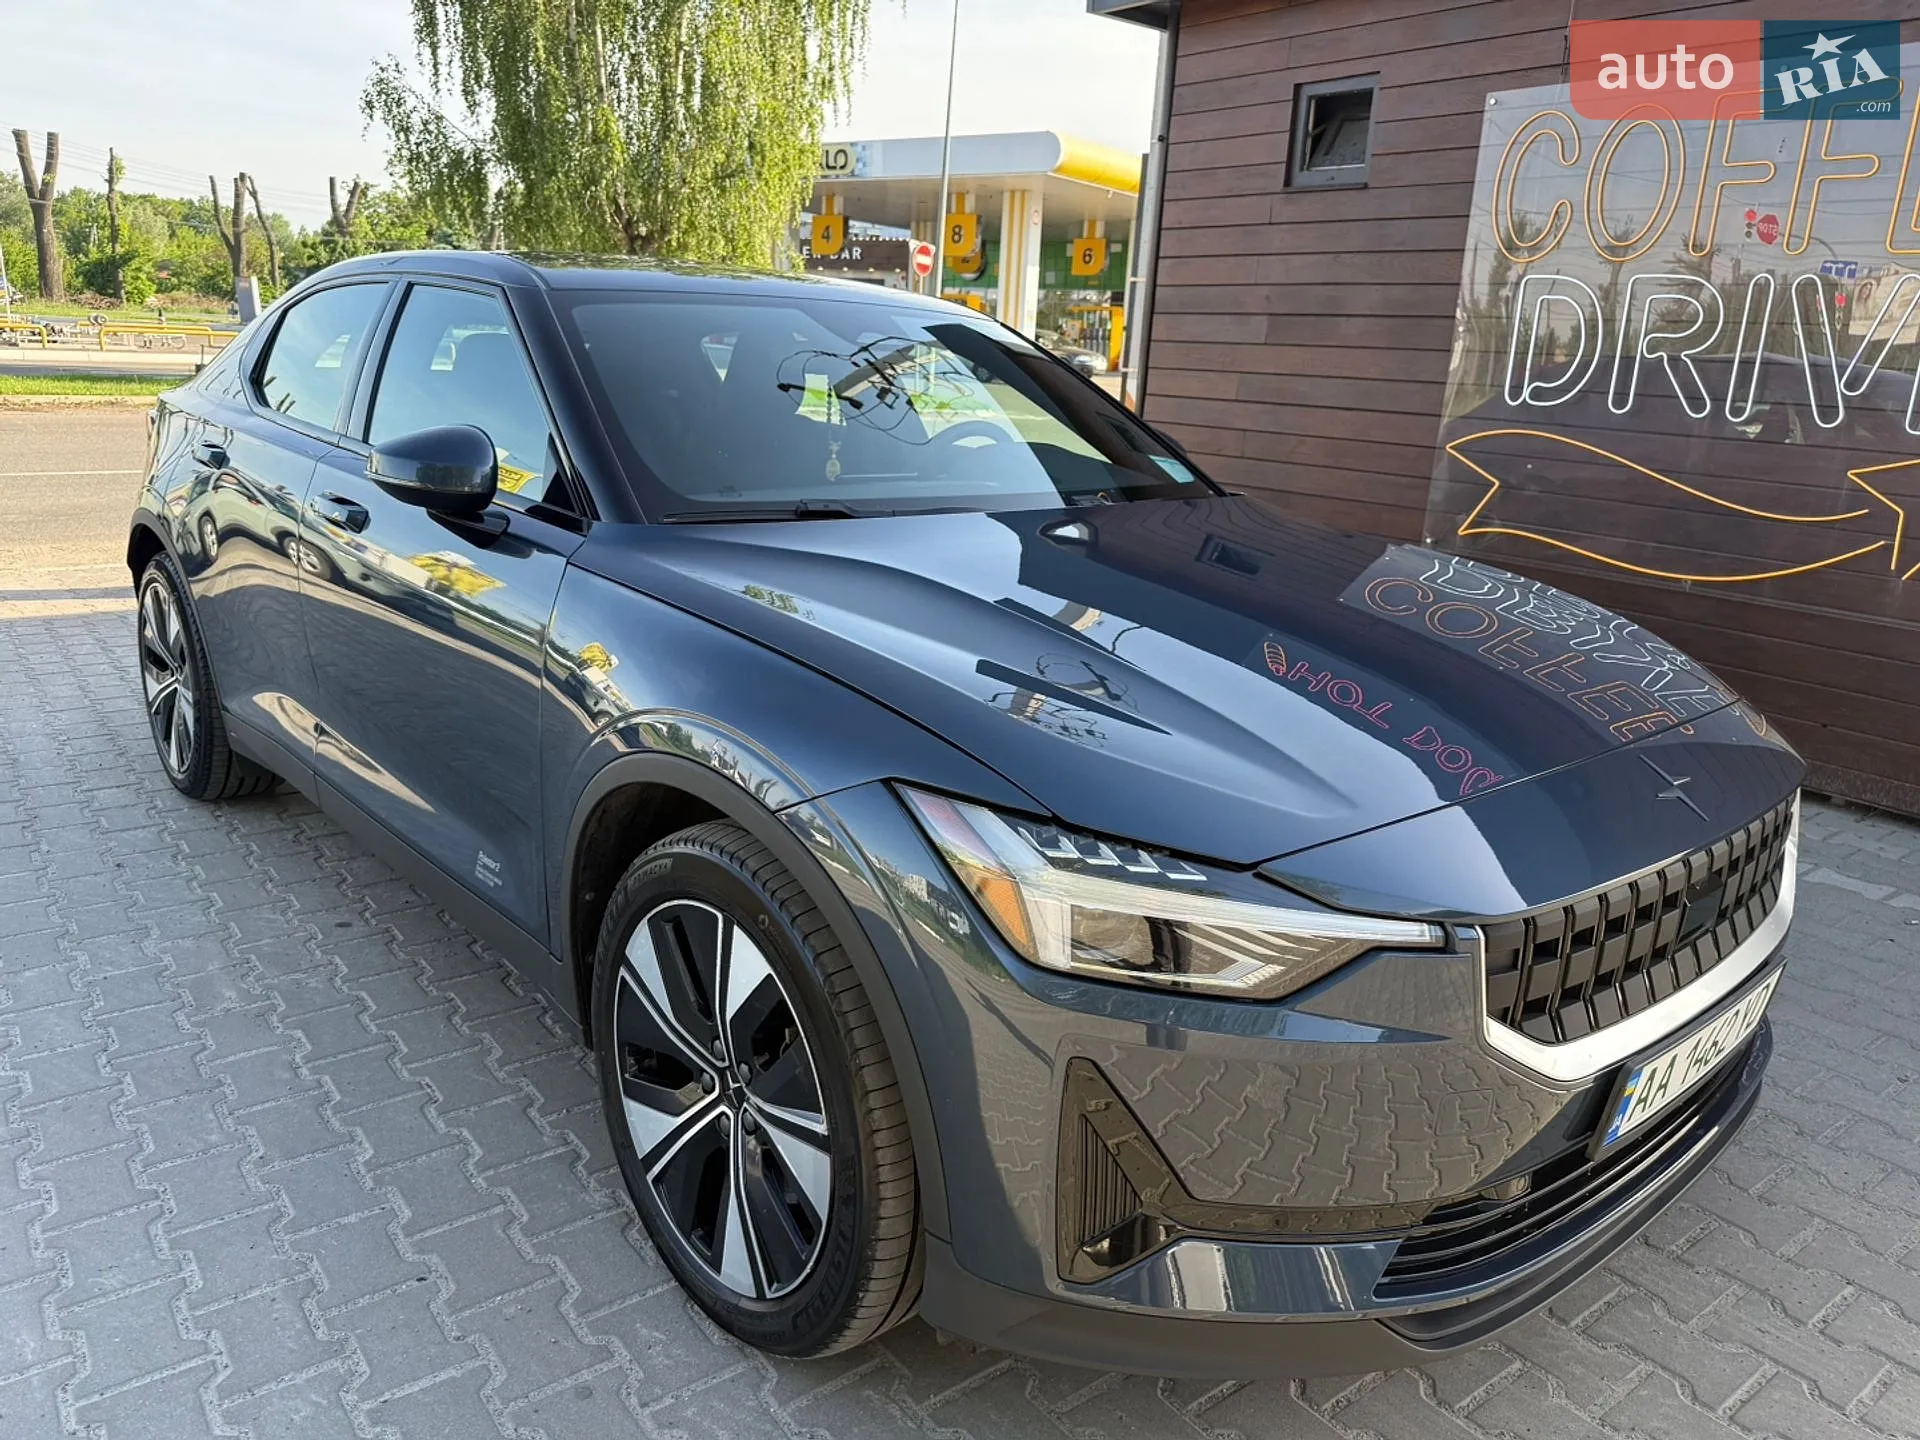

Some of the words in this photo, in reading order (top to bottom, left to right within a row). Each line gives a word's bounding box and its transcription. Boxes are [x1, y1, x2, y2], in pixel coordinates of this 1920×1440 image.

[820, 148, 849, 171] LO
[820, 224, 831, 243] 4
[952, 224, 963, 244] 8
[1082, 247, 1093, 265] 6
[1504, 274, 1920, 435] DRIV
[1626, 1052, 1678, 1123] AA
[1681, 1008, 1740, 1085] 1462
